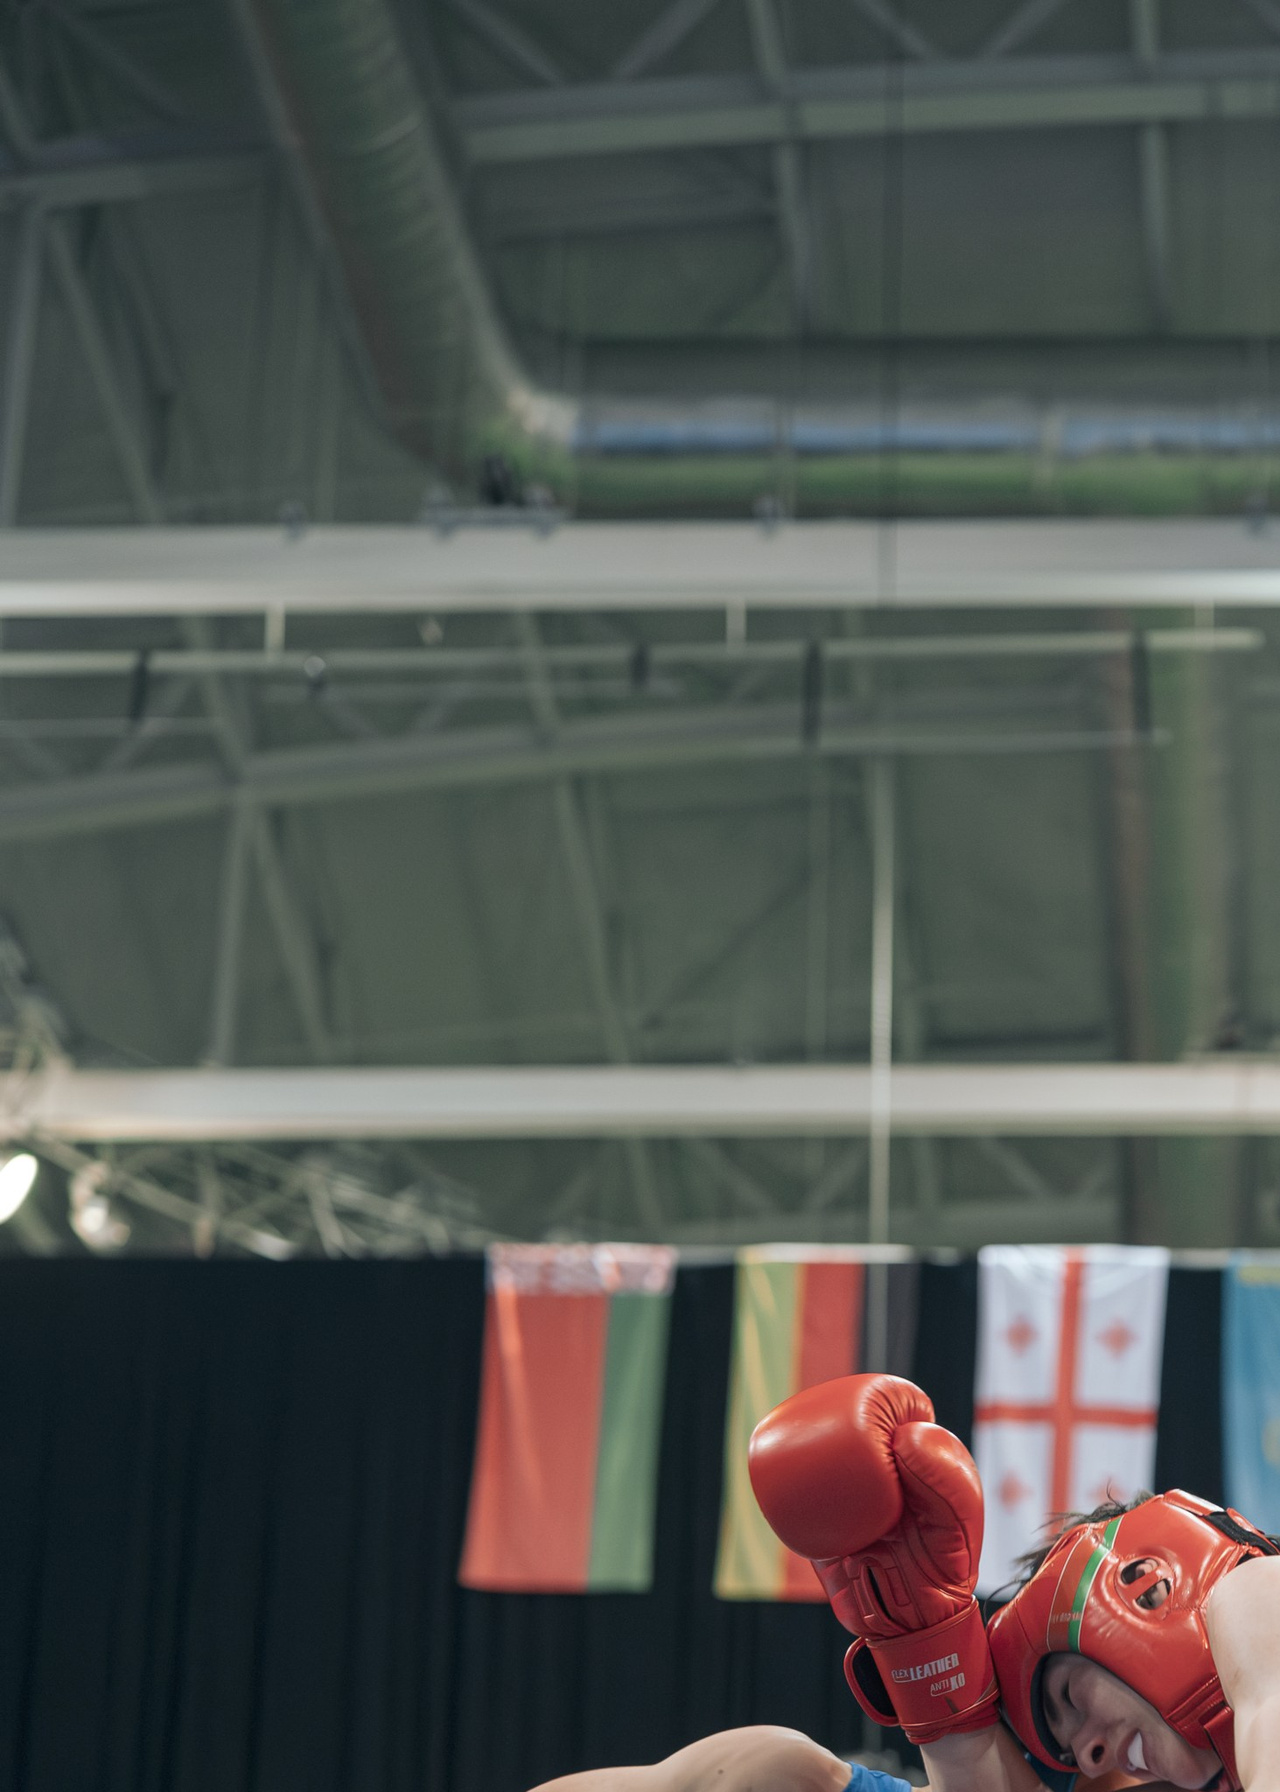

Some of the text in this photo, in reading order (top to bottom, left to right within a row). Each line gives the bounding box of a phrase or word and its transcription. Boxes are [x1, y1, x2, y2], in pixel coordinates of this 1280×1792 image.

[909, 1652, 960, 1681] LEATHER
[931, 1672, 966, 1692] ANTI KO
